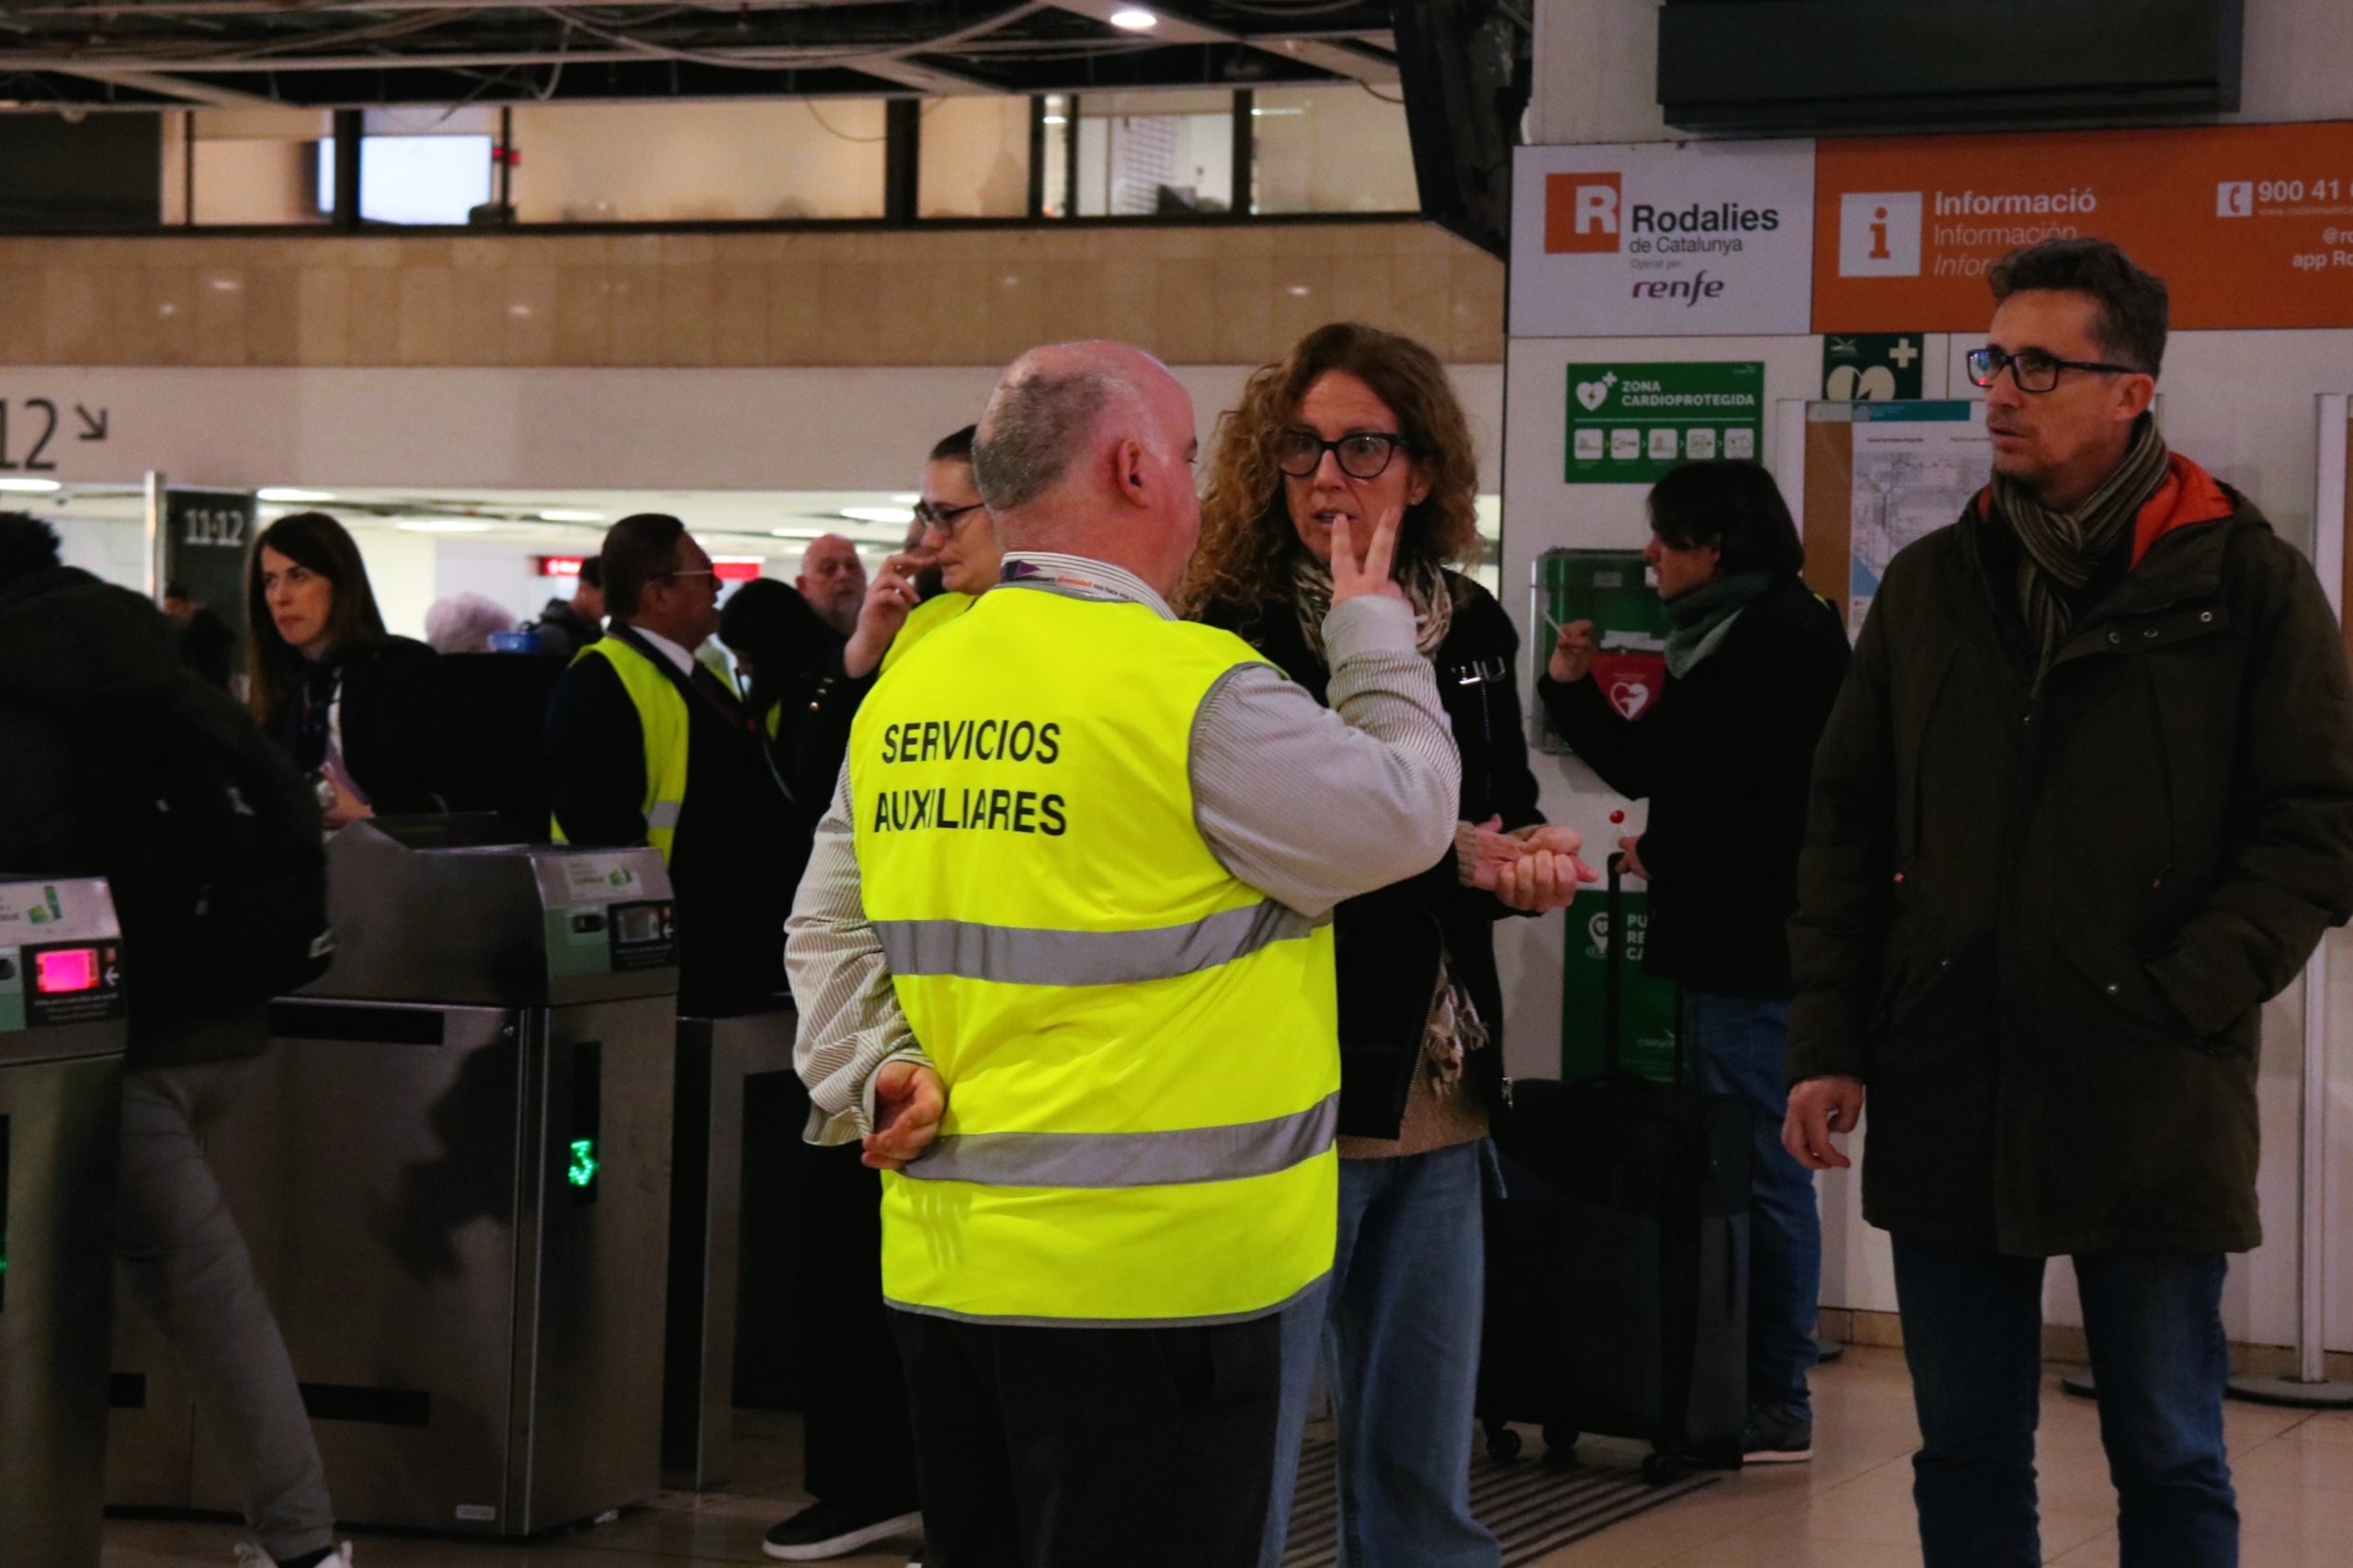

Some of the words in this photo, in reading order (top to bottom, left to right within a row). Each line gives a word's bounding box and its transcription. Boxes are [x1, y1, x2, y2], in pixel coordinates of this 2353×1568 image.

[1935, 187, 2097, 215] Informació
[2258, 181, 2304, 201] 900
[2312, 179, 2340, 200] 41
[1631, 203, 1779, 233] Rodalies
[1630, 238, 1651, 254] de
[1656, 236, 1743, 256] Catalunya
[2293, 253, 2327, 271] app
[1632, 270, 1724, 308] renfe
[1621, 381, 1661, 392] ZONA
[1621, 394, 1756, 406] CARDIOPROTEGIDA
[881, 719, 1061, 764] SERVICIOS
[873, 788, 1066, 836] AUXILIARES
[569, 1140, 594, 1186] 3
